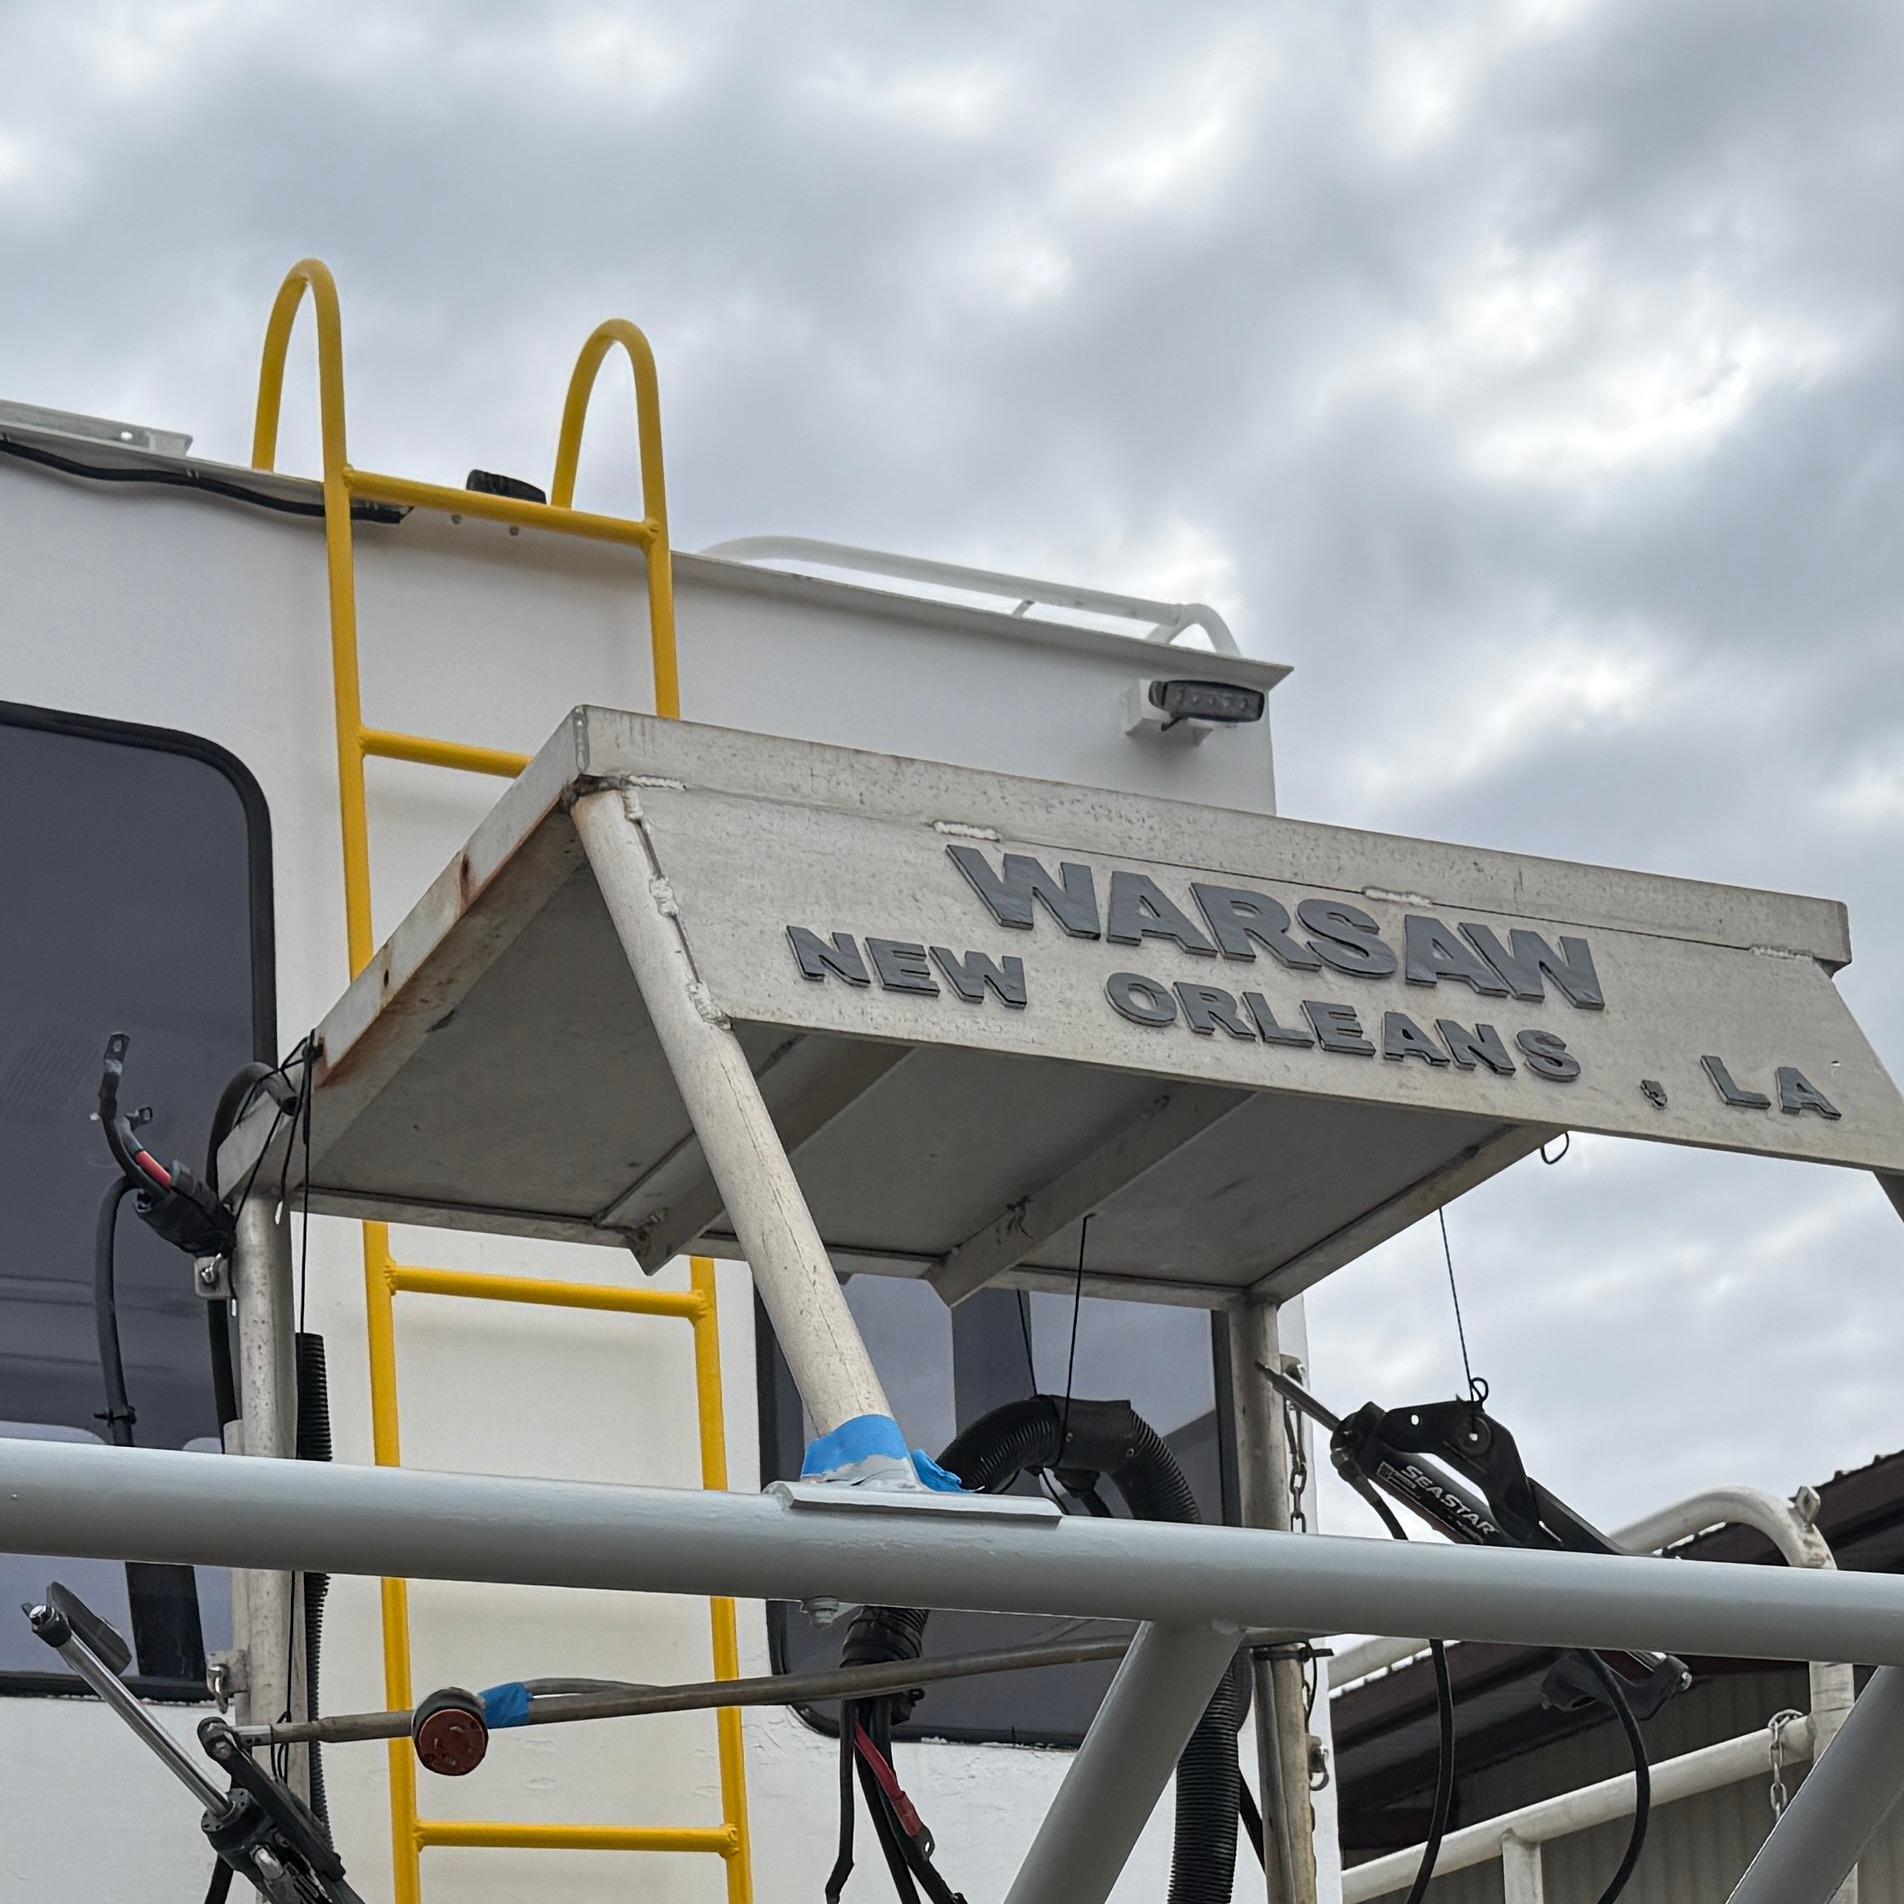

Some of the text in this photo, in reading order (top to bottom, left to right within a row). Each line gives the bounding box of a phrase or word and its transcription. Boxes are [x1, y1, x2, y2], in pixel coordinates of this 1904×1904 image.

[944, 843, 1606, 1011] WARSAW
[786, 924, 1028, 1010] NEW
[1103, 970, 1583, 1083] ORLEANS
[1699, 1054, 1843, 1121] LA
[1400, 1464, 1500, 1536] SEASTAR
